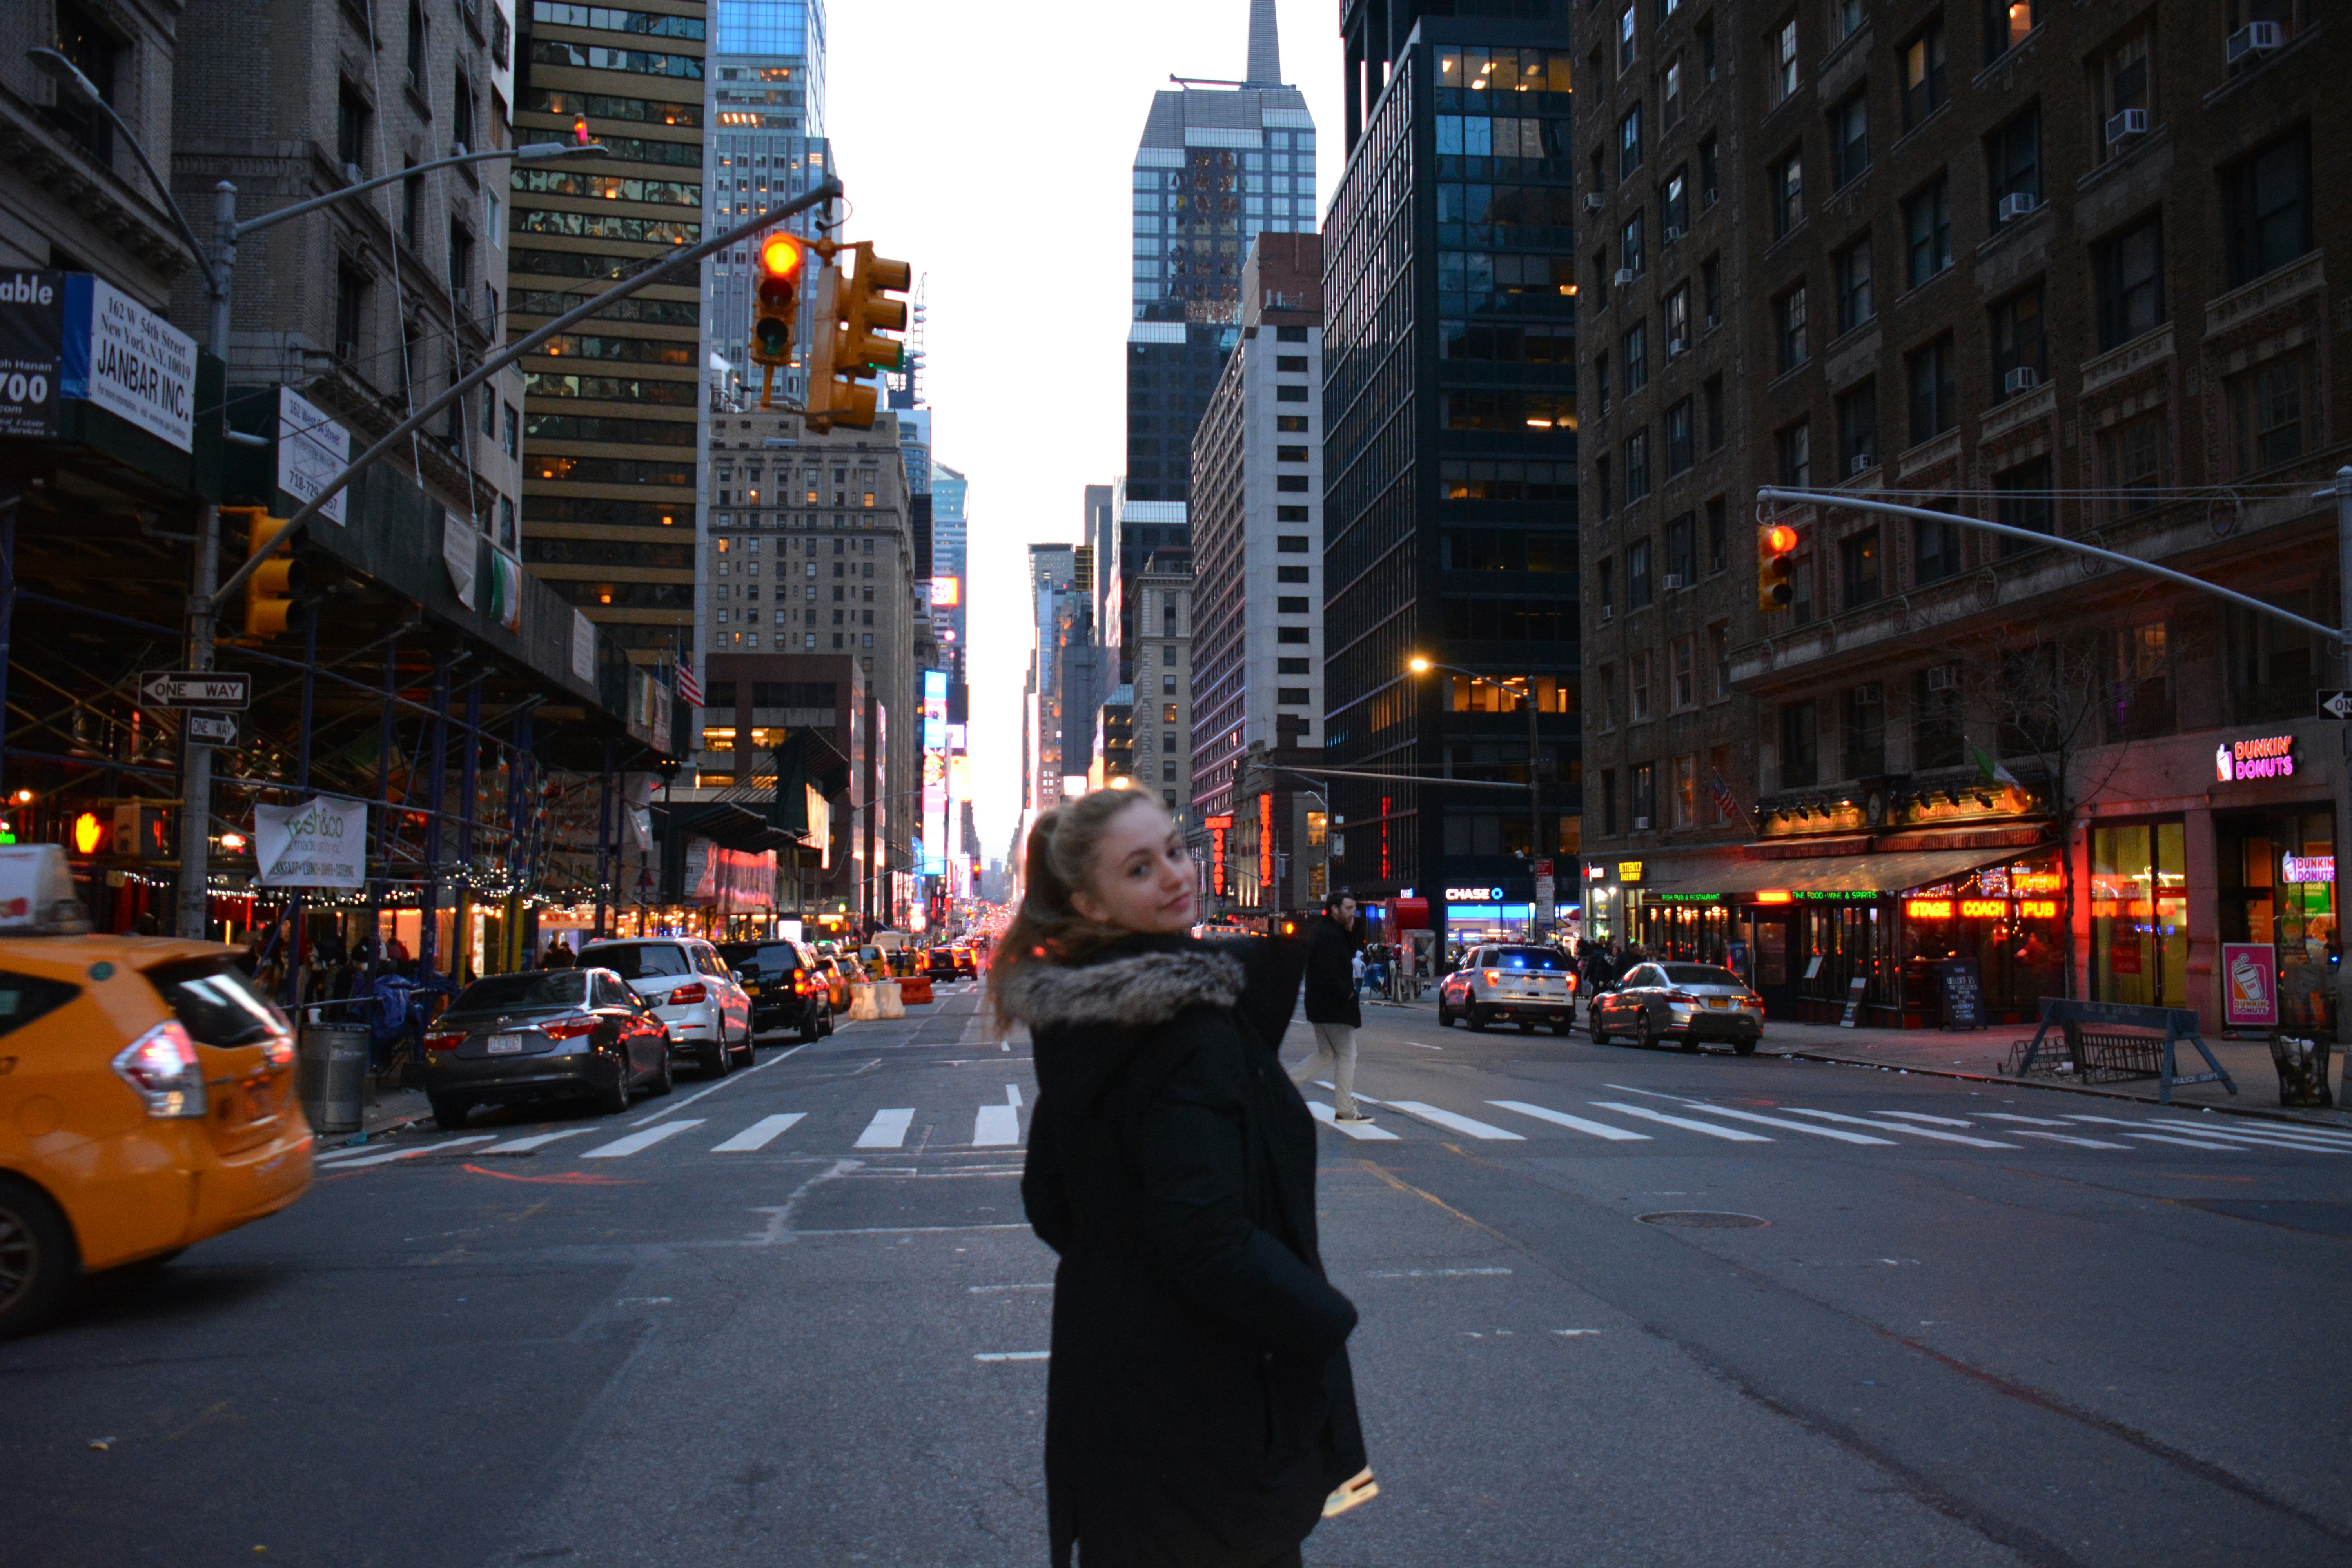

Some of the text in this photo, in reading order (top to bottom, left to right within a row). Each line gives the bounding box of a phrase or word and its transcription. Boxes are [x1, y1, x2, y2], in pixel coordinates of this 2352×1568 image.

[109, 297, 185, 358] 162 W 54th Street
[101, 313, 121, 339] New
[169, 354, 190, 380] 10019
[98, 339, 188, 422] JANBAR INC.
[290, 399, 301, 418] 162
[155, 683, 239, 697] ONE WAY
[193, 720, 231, 735] ONE WAY
[2235, 735, 2292, 760] DUNKIN'
[2236, 755, 2293, 779] DONUTS
[1619, 862, 1642, 873] BUTTERCUP
[2298, 858, 2334, 869] DUNKIN
[2013, 874, 2060, 890] TAVERN
[2298, 870, 2335, 881] DONUTS
[1446, 888, 1490, 900] CHASE
[1909, 901, 2055, 917] STAGE COACH PUB
[2172, 1072, 2218, 1084] POLICE DEPT
